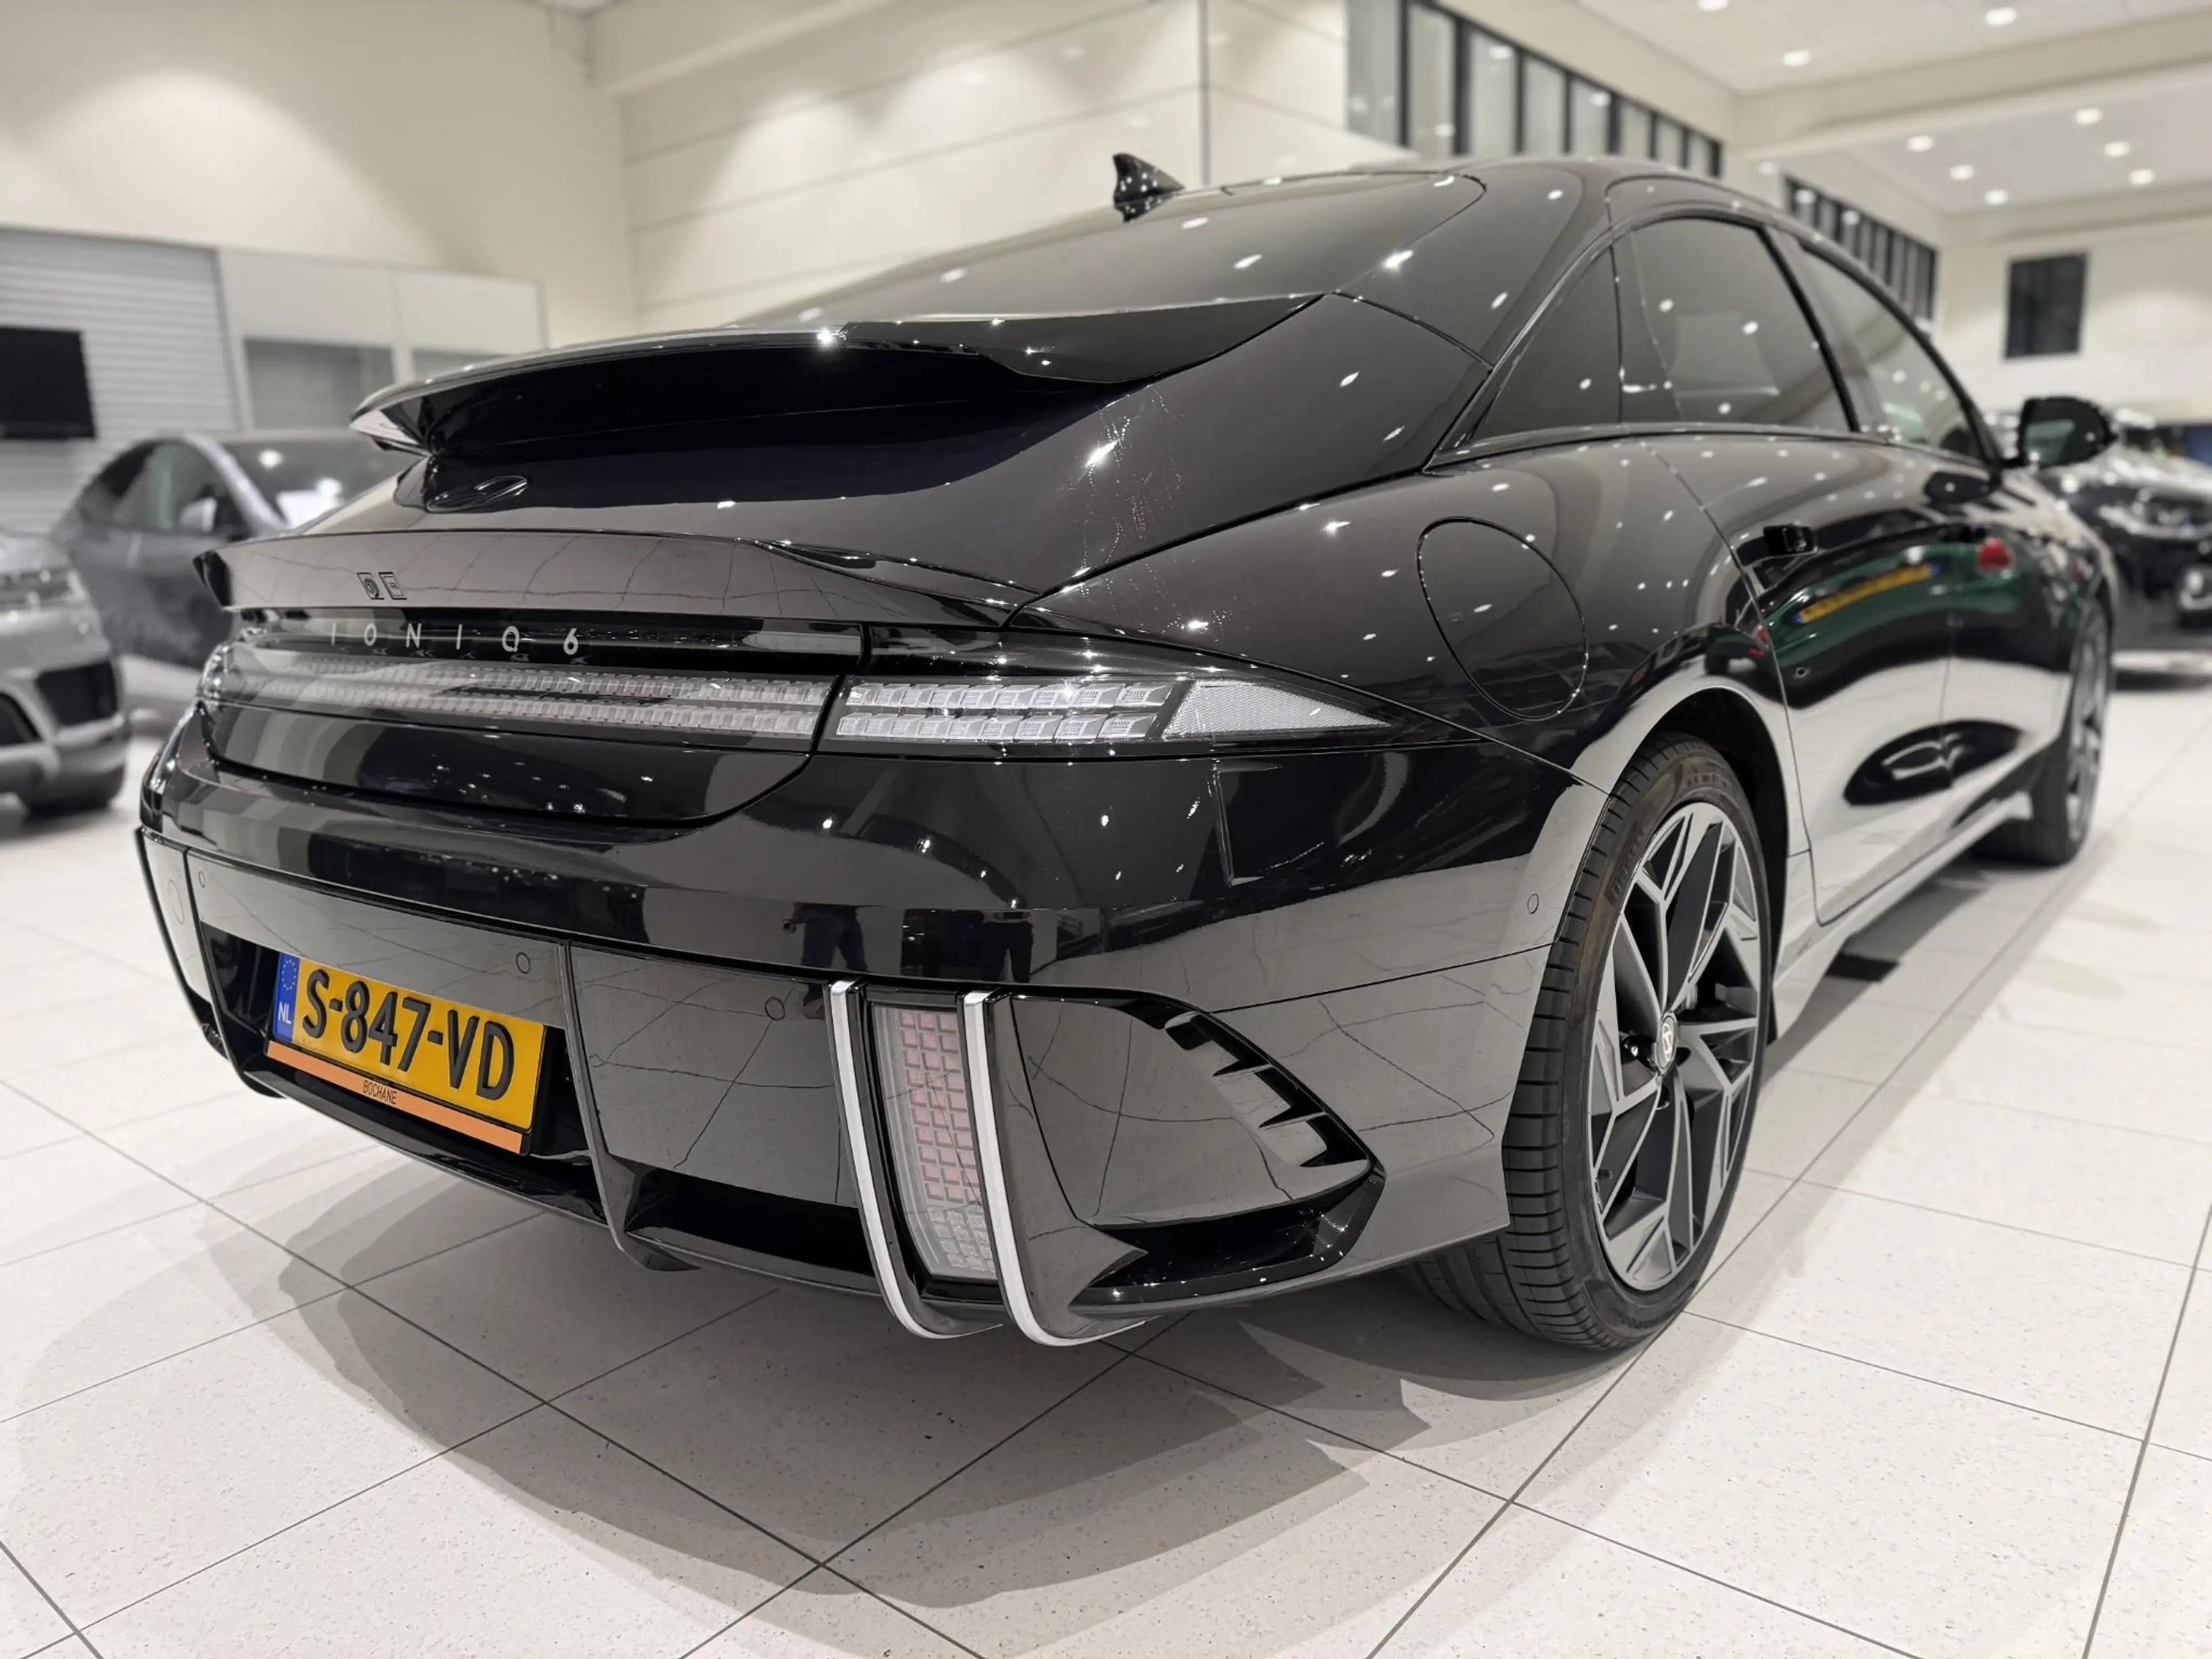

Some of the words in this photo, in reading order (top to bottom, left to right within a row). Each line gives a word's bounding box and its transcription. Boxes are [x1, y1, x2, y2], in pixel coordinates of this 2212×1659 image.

[331, 622, 520, 653] IONIQ
[563, 627, 579, 656] 6
[278, 1001, 292, 1025] NL
[302, 969, 514, 1100] S-847-VD
[362, 1080, 397, 1105] BOCHANE
